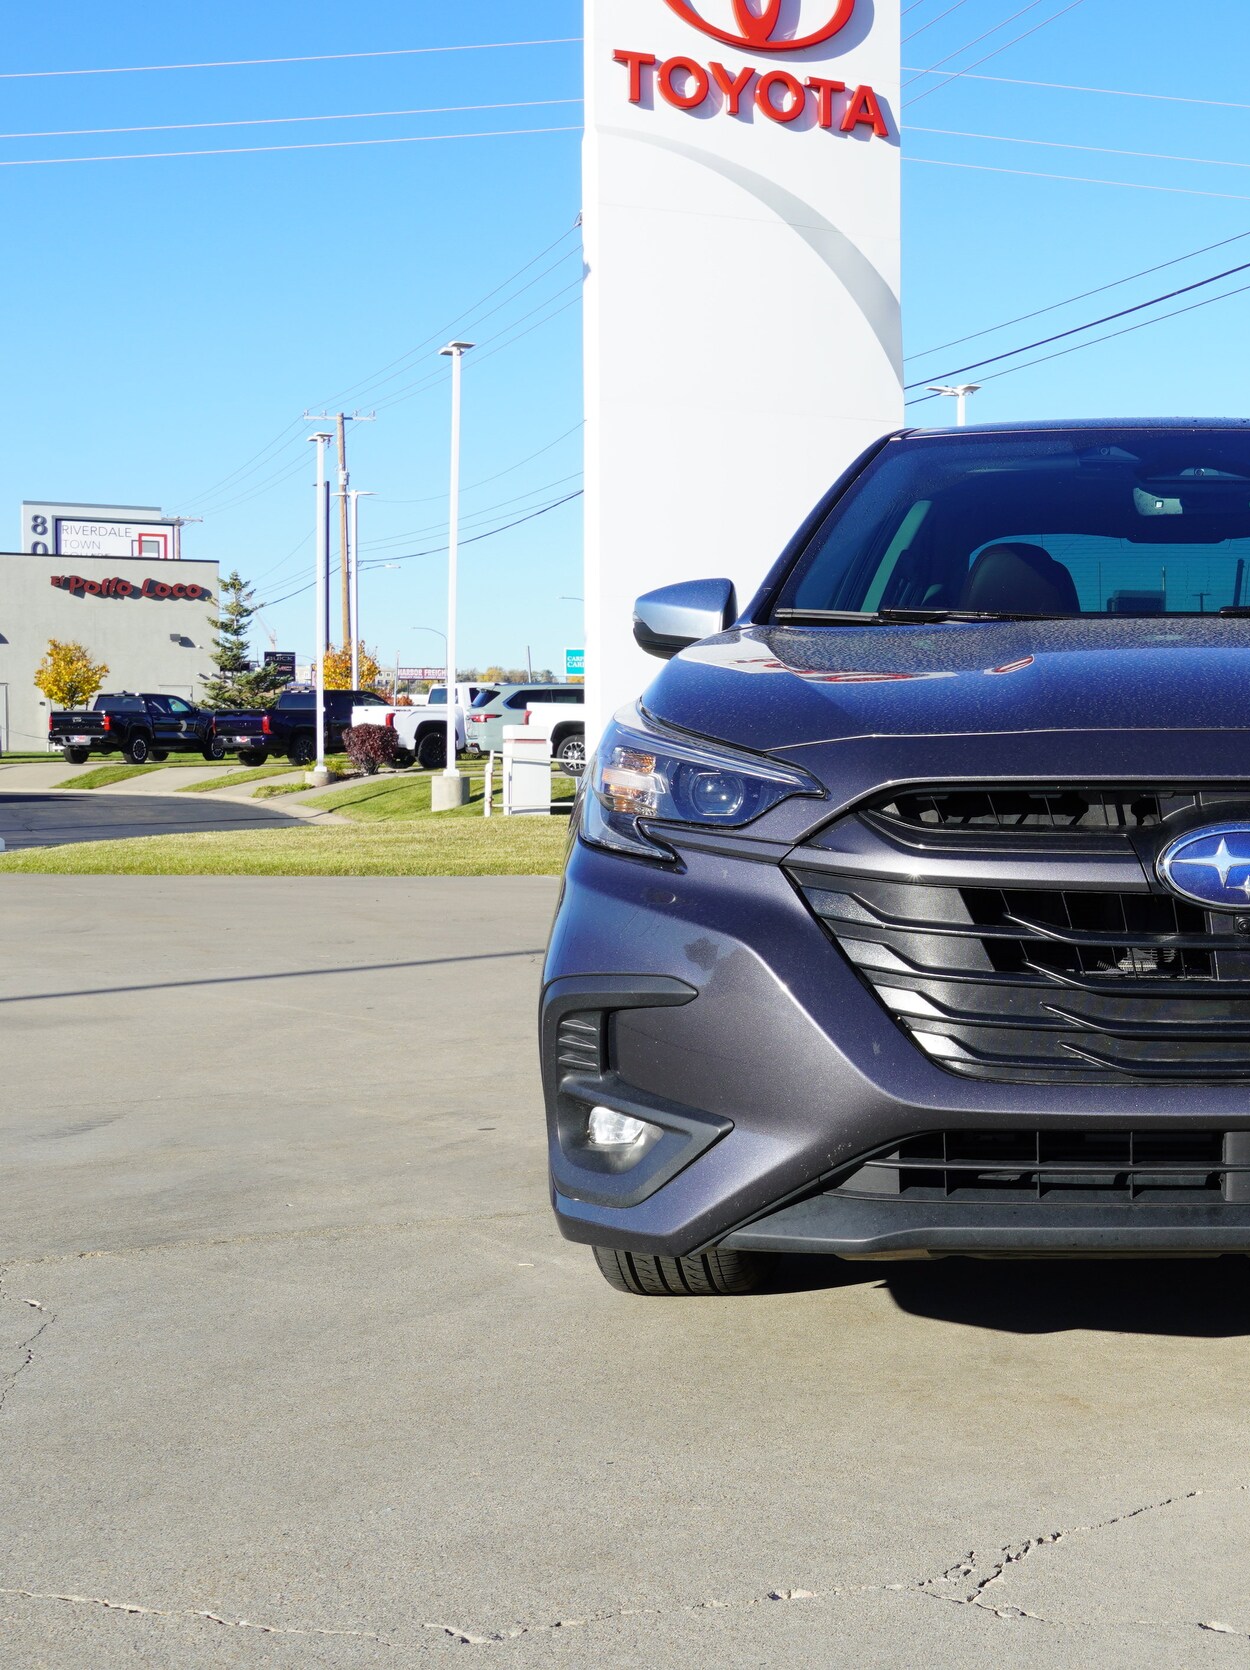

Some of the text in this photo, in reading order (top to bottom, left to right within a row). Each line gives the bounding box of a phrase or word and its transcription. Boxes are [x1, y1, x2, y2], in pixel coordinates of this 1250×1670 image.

[612, 49, 888, 137] TOYOTA
[62, 525, 132, 538] RIVERDALE
[64, 539, 100, 550] TOWN
[51, 575, 202, 598] El Pollo Loco
[424, 669, 446, 677] FREIGH
